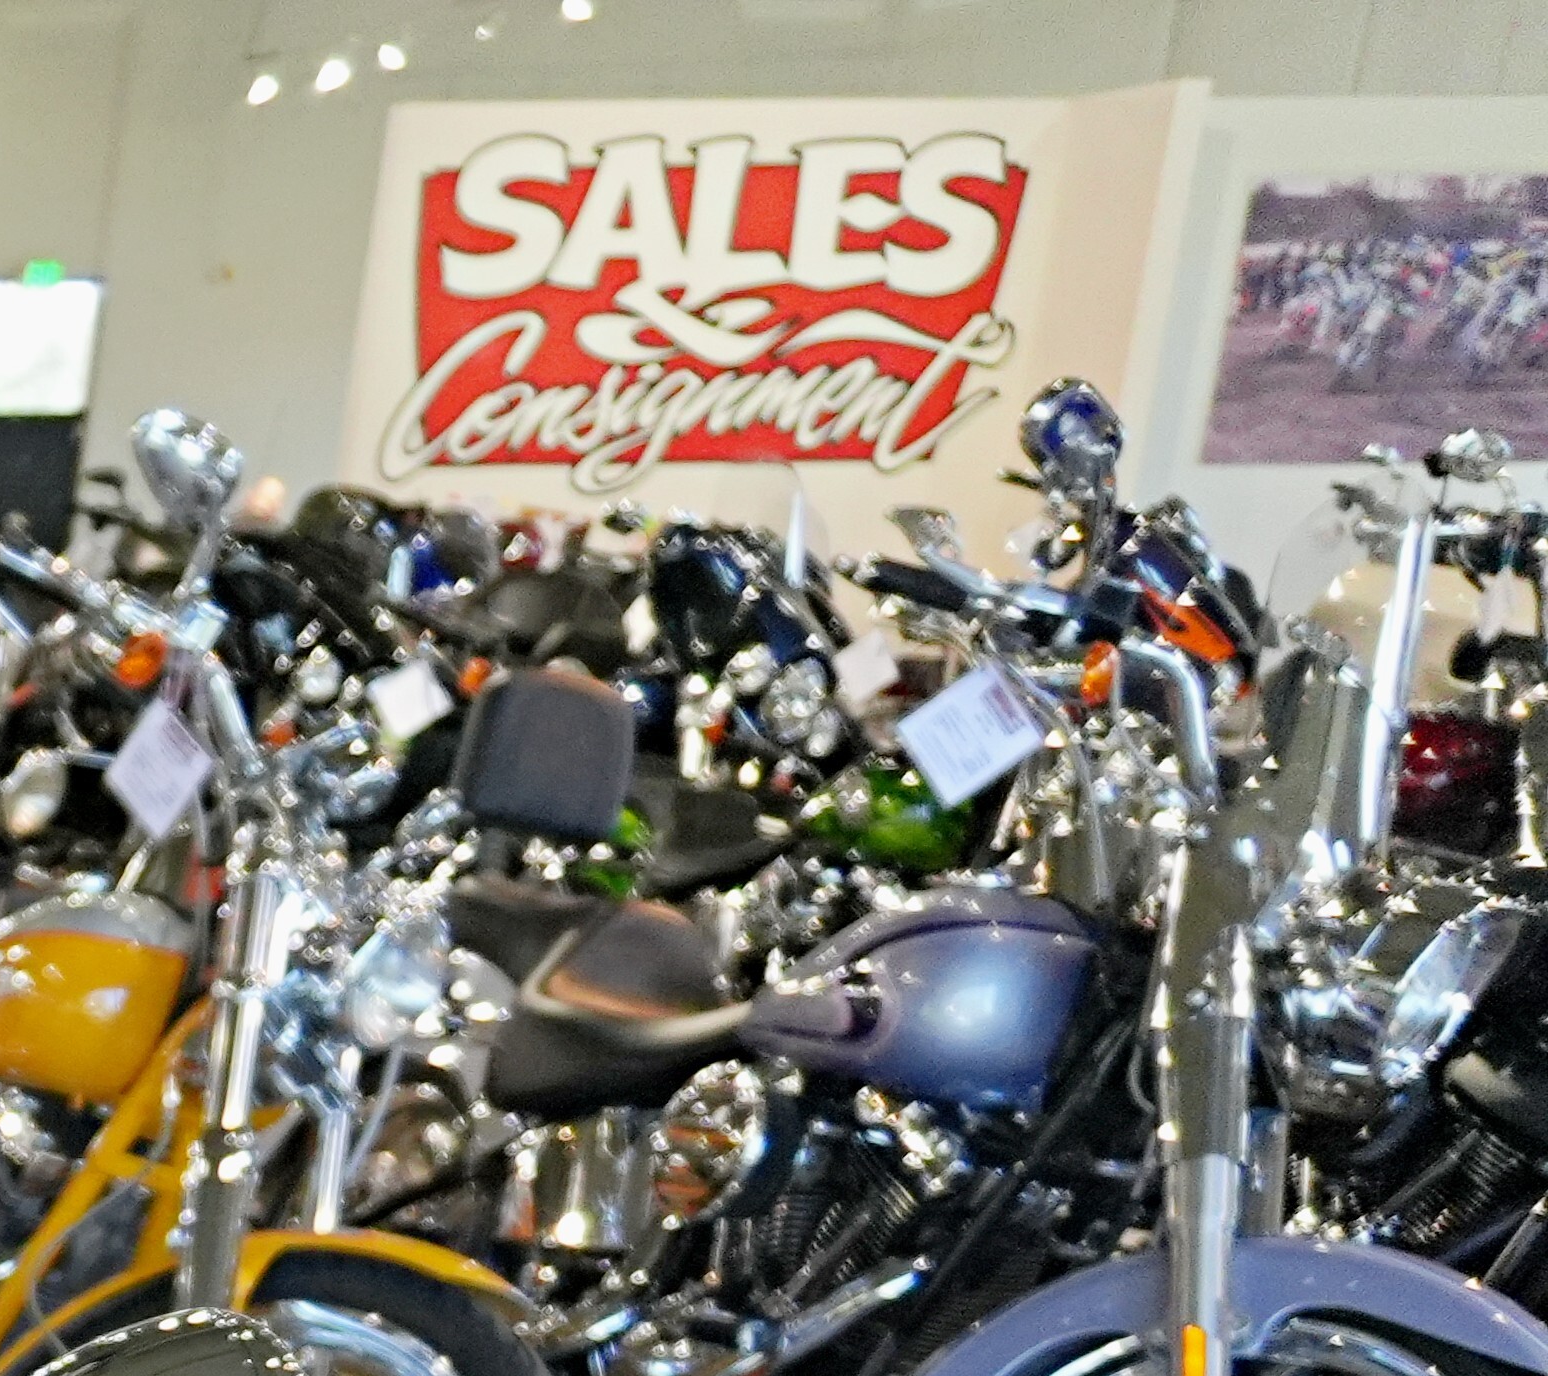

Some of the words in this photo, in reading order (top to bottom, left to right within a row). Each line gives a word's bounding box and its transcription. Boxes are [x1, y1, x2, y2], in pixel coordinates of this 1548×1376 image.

[439, 132, 1009, 298] SALES
[378, 308, 1016, 494] Consignment
[574, 280, 798, 367] &
